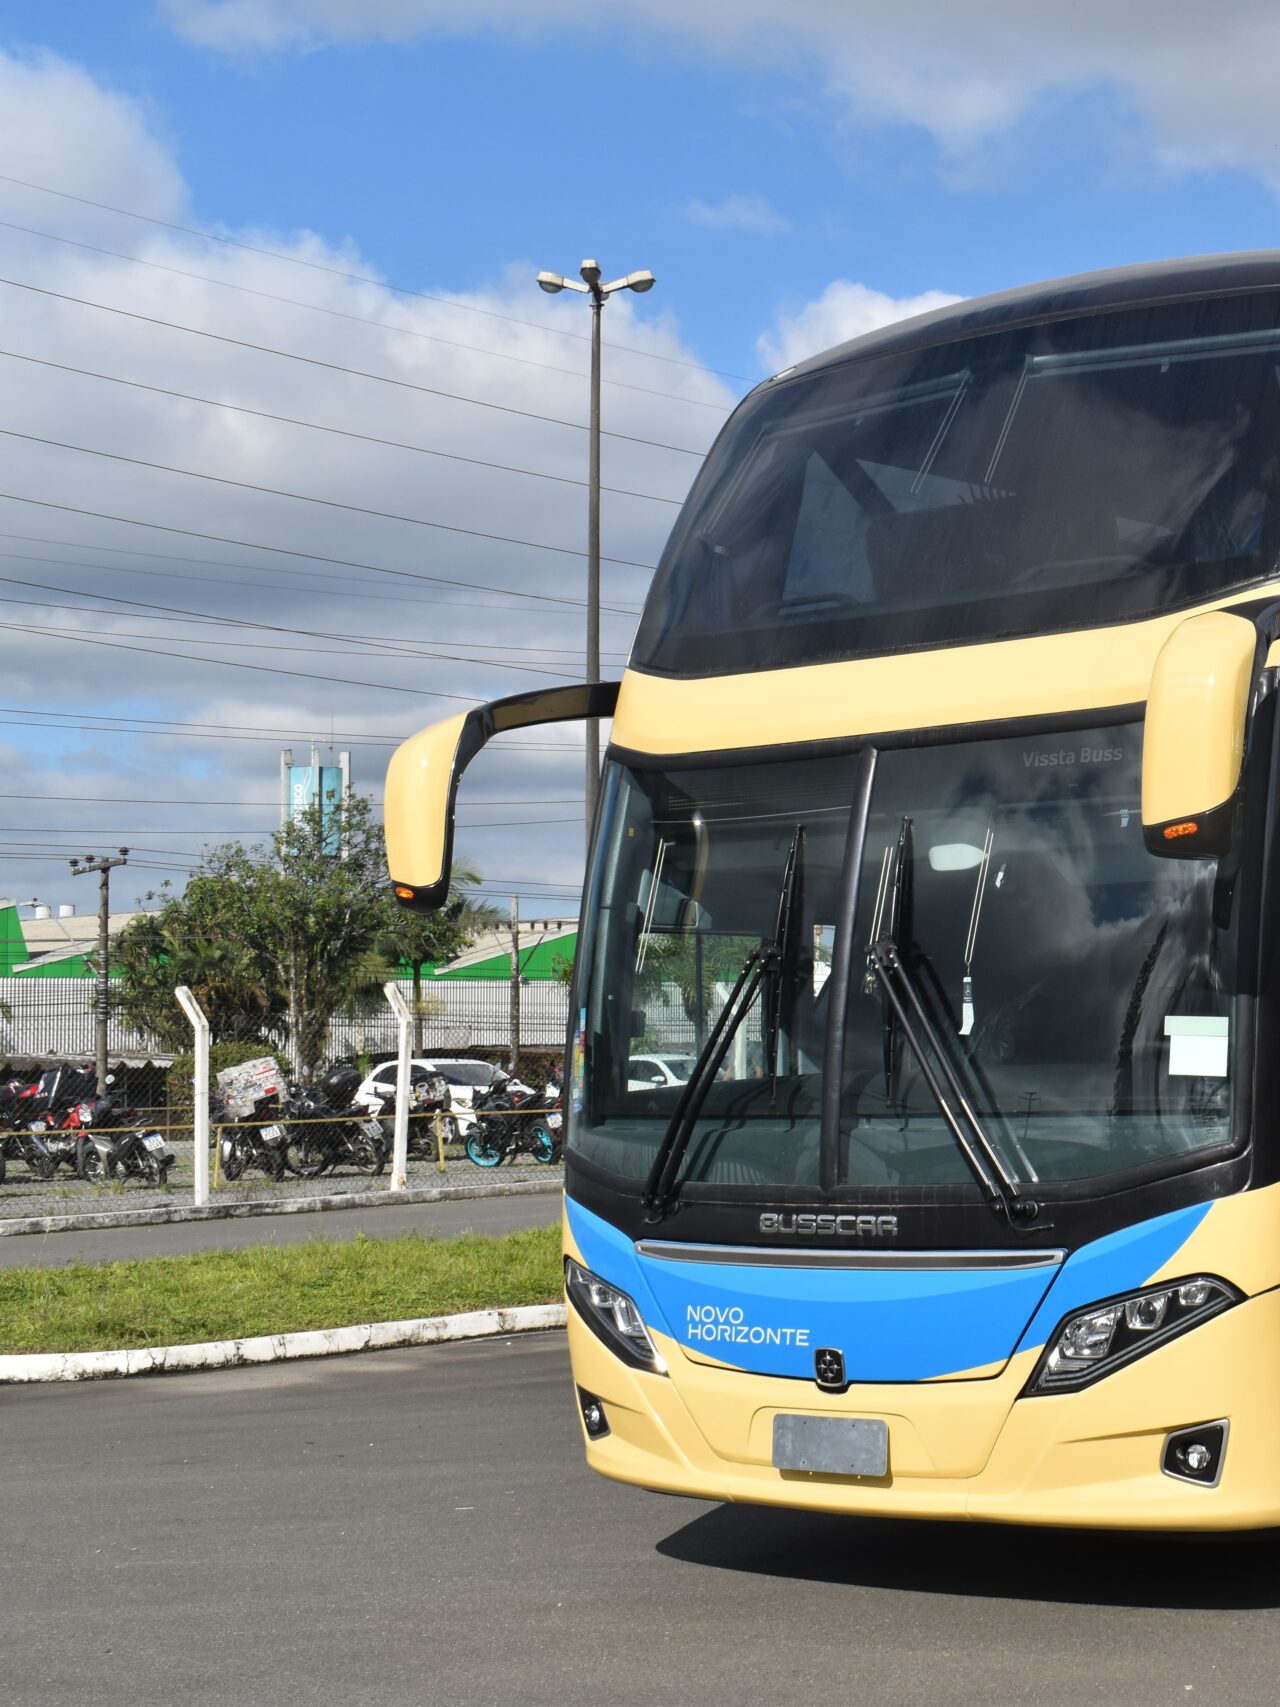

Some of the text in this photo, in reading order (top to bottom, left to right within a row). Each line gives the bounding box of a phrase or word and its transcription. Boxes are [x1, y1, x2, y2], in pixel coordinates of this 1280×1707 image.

[1022, 747, 1124, 768] Vissta Buss
[759, 1213, 898, 1237] BUSSCAR
[686, 1304, 744, 1325] NOVO
[688, 1323, 811, 1347] HORIZONTE
